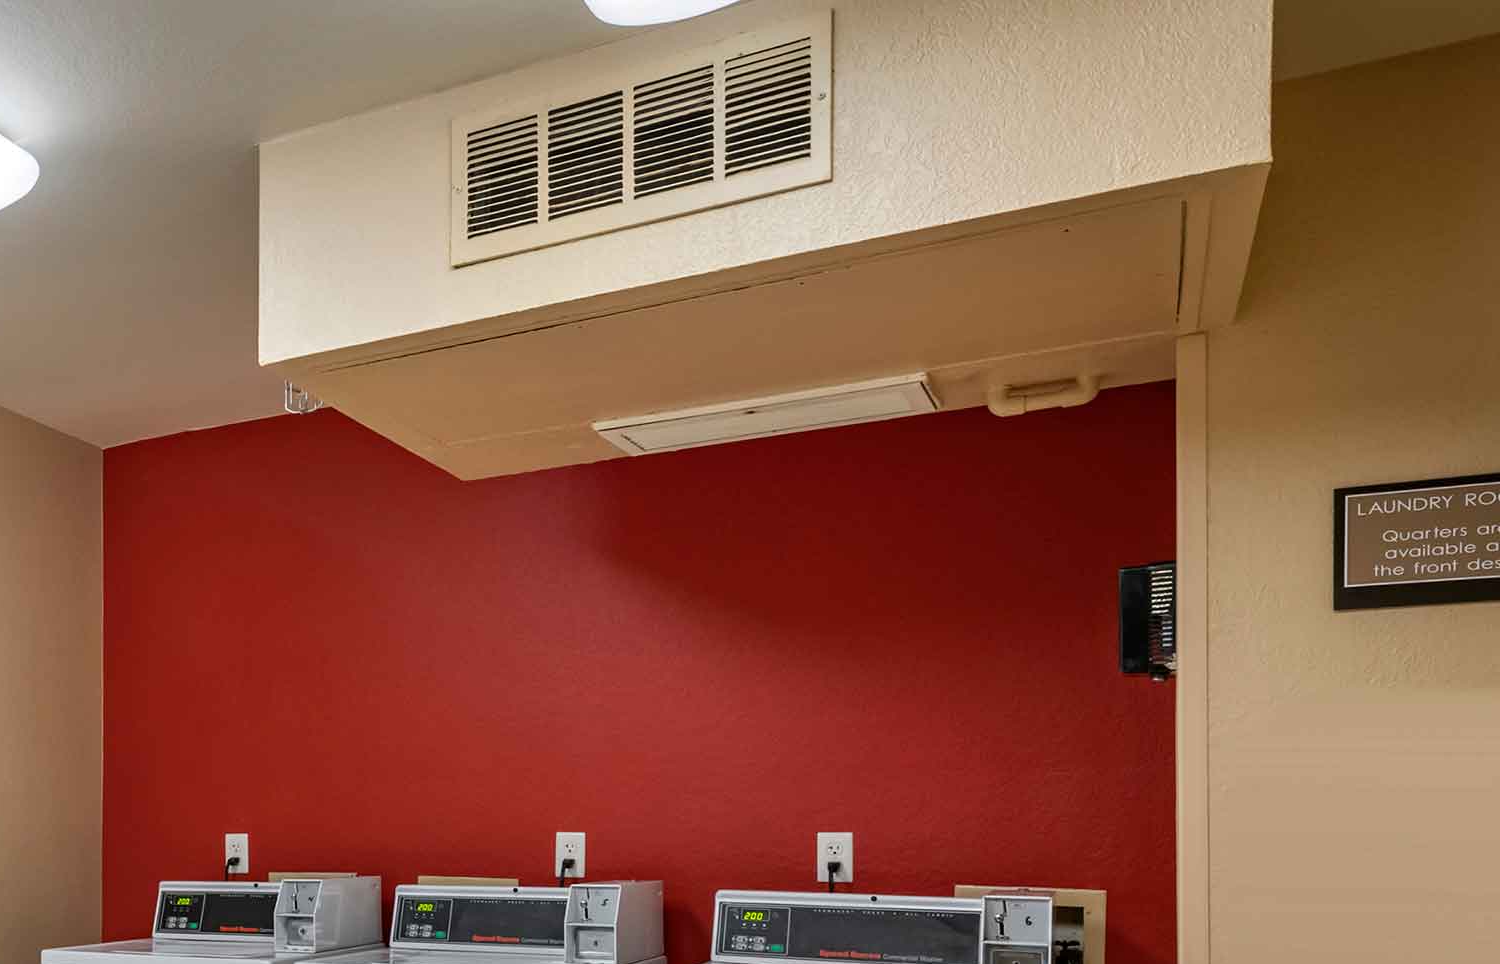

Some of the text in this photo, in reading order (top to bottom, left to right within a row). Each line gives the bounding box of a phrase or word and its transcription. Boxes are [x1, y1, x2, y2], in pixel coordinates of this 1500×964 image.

[1357, 491, 1500, 516] LAUNDRY RO
[1382, 524, 1500, 543] Quarters ar
[1385, 541, 1477, 560] available
[1373, 563, 1405, 577] the
[1414, 559, 1458, 574] front
[417, 903, 434, 912] 200
[743, 911, 764, 921] 200
[1025, 915, 1033, 926] 6
